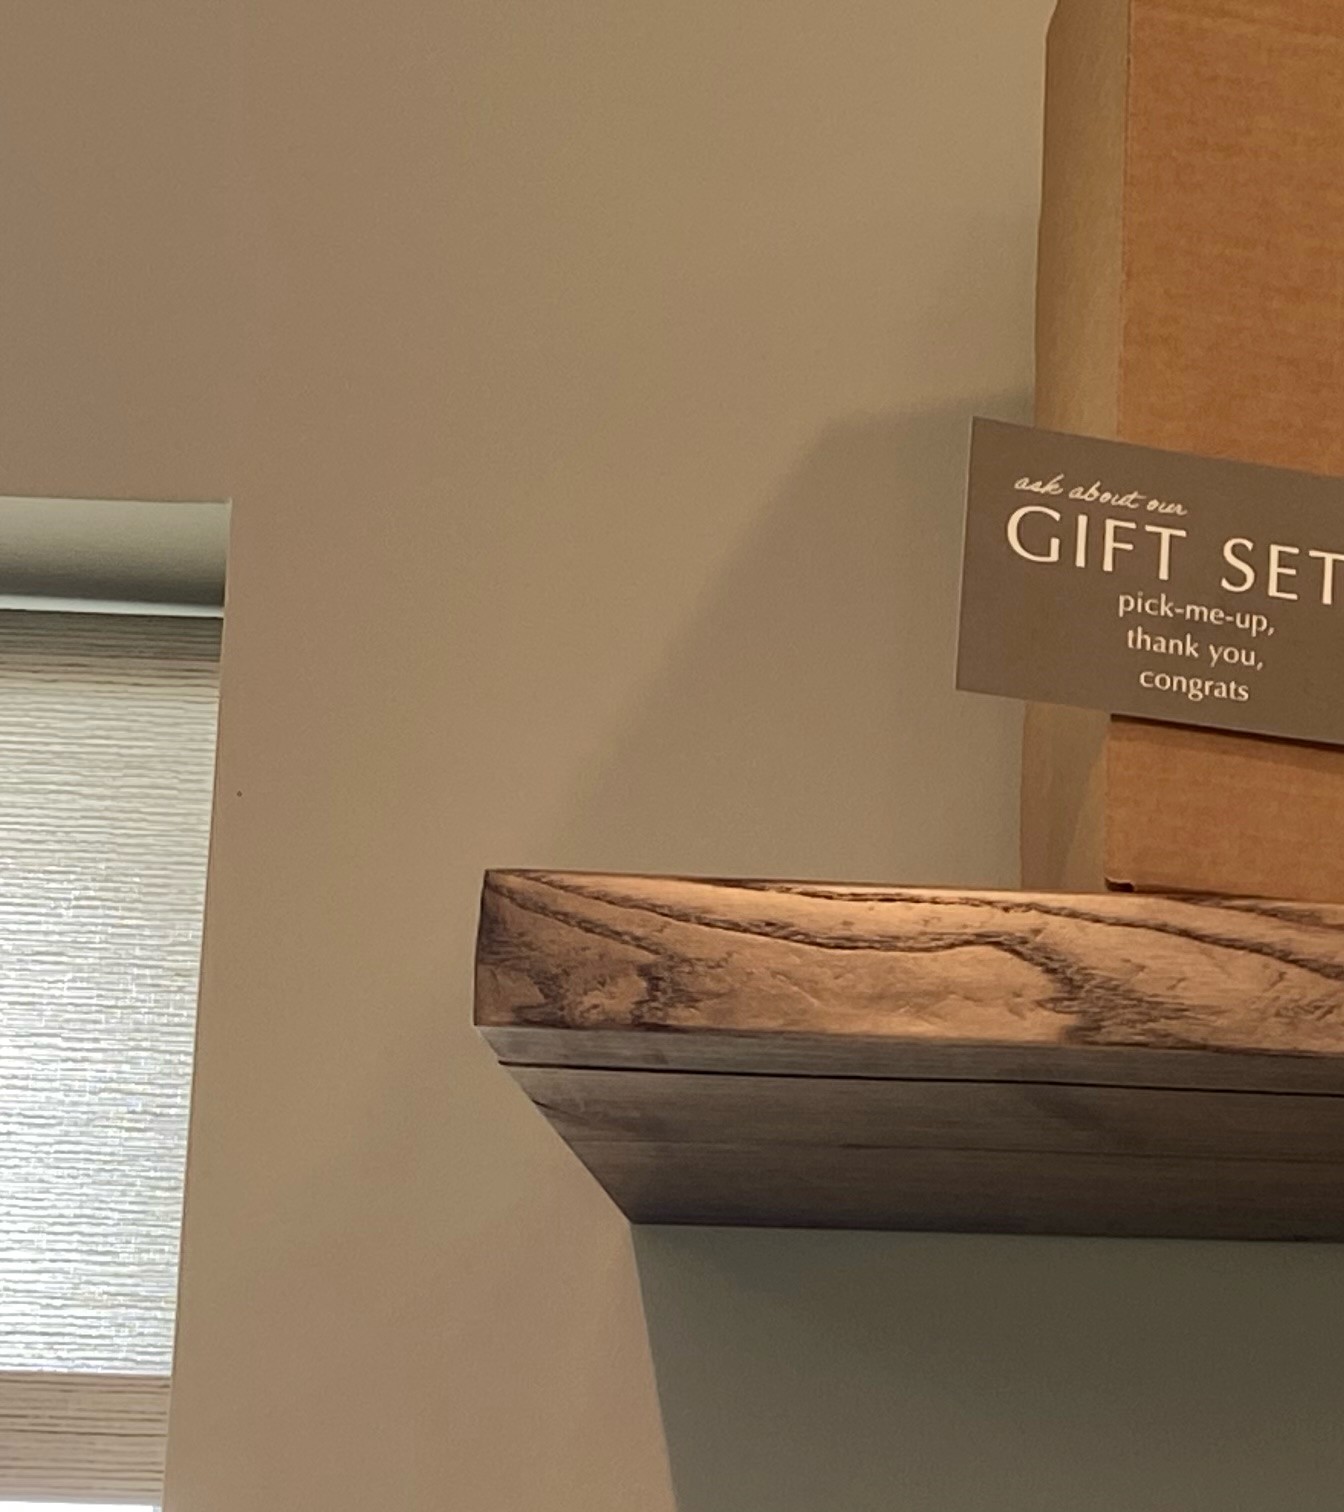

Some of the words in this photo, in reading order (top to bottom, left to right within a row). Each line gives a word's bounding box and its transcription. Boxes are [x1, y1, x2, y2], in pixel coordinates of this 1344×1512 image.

[1014, 474, 1064, 494] ask
[1069, 480, 1147, 508] about
[1147, 499, 1188, 515] our
[1007, 505, 1187, 580] GIFT
[1118, 592, 1275, 636] pick-me-up,
[1126, 628, 1199, 658] thank
[1208, 644, 1264, 670] you,
[1139, 669, 1249, 702] congrats
